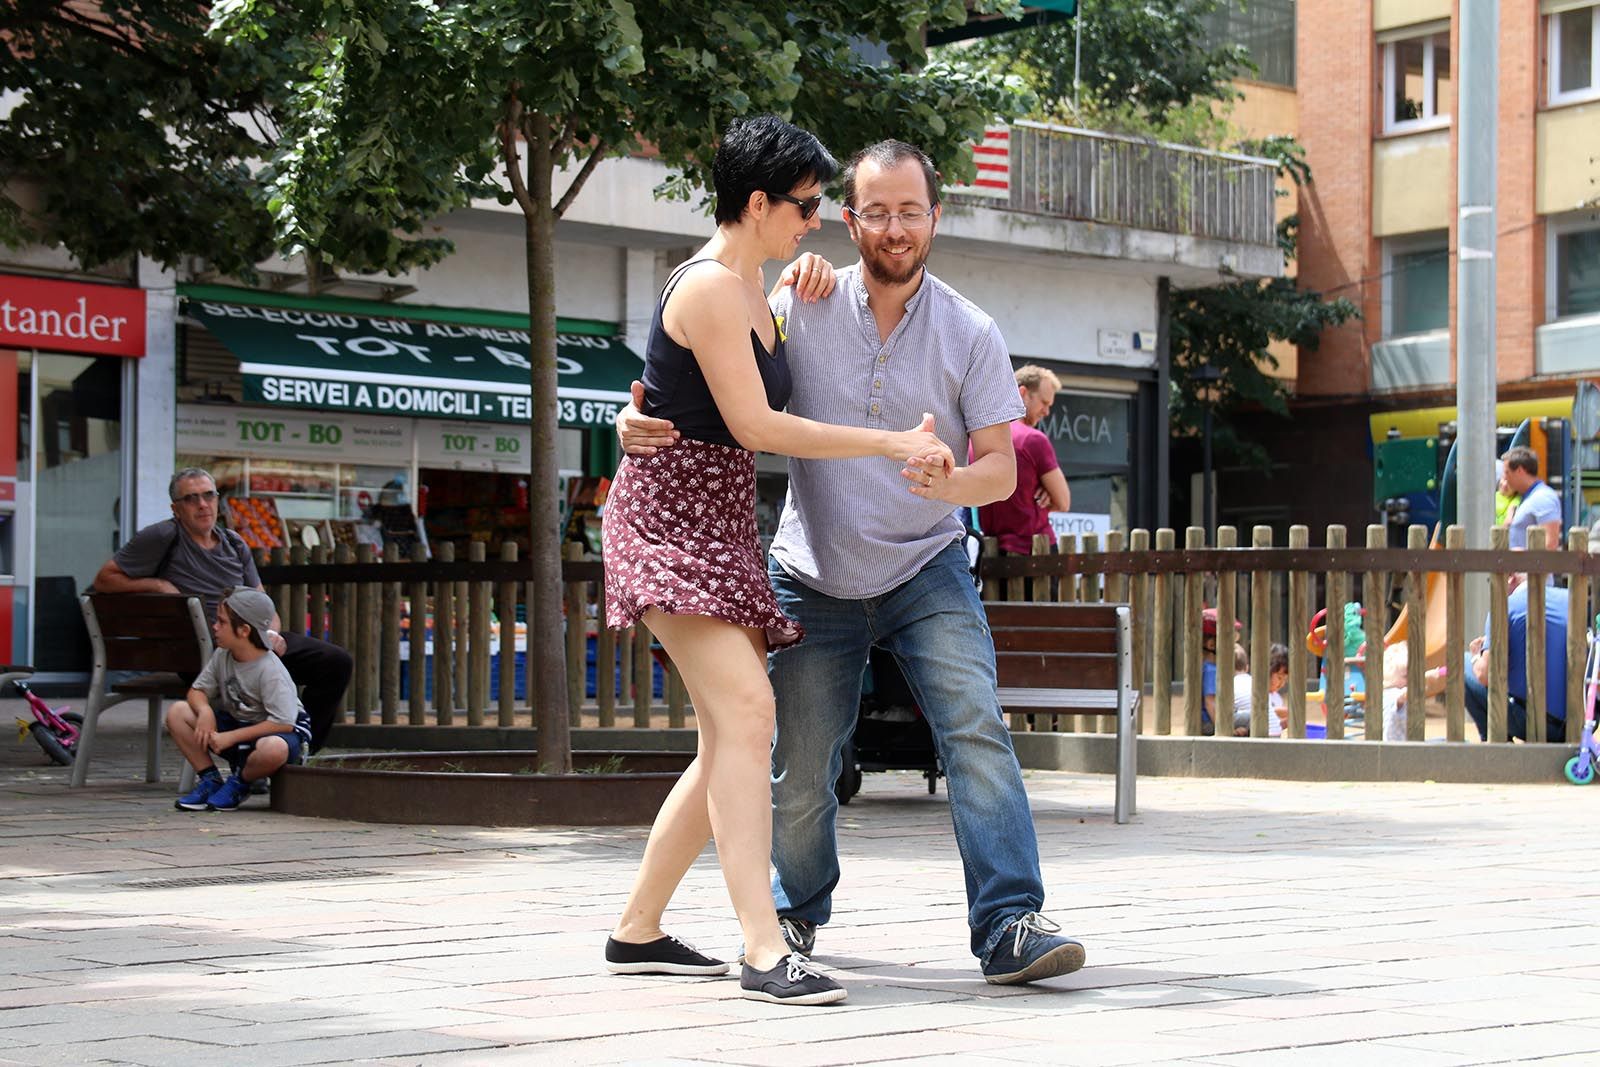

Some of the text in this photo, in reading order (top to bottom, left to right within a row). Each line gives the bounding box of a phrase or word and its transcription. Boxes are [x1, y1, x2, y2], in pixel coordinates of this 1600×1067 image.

[368, 318, 414, 336] EN
[296, 334, 432, 363] TOT
[262, 377, 349, 406] SERVEI
[354, 384, 373, 408] A
[377, 387, 481, 416] DOMICILI
[581, 401, 617, 425] 675
[236, 420, 285, 442] TOT
[308, 423, 343, 444] BO
[442, 434, 477, 451] TOT
[495, 437, 520, 453] BO
